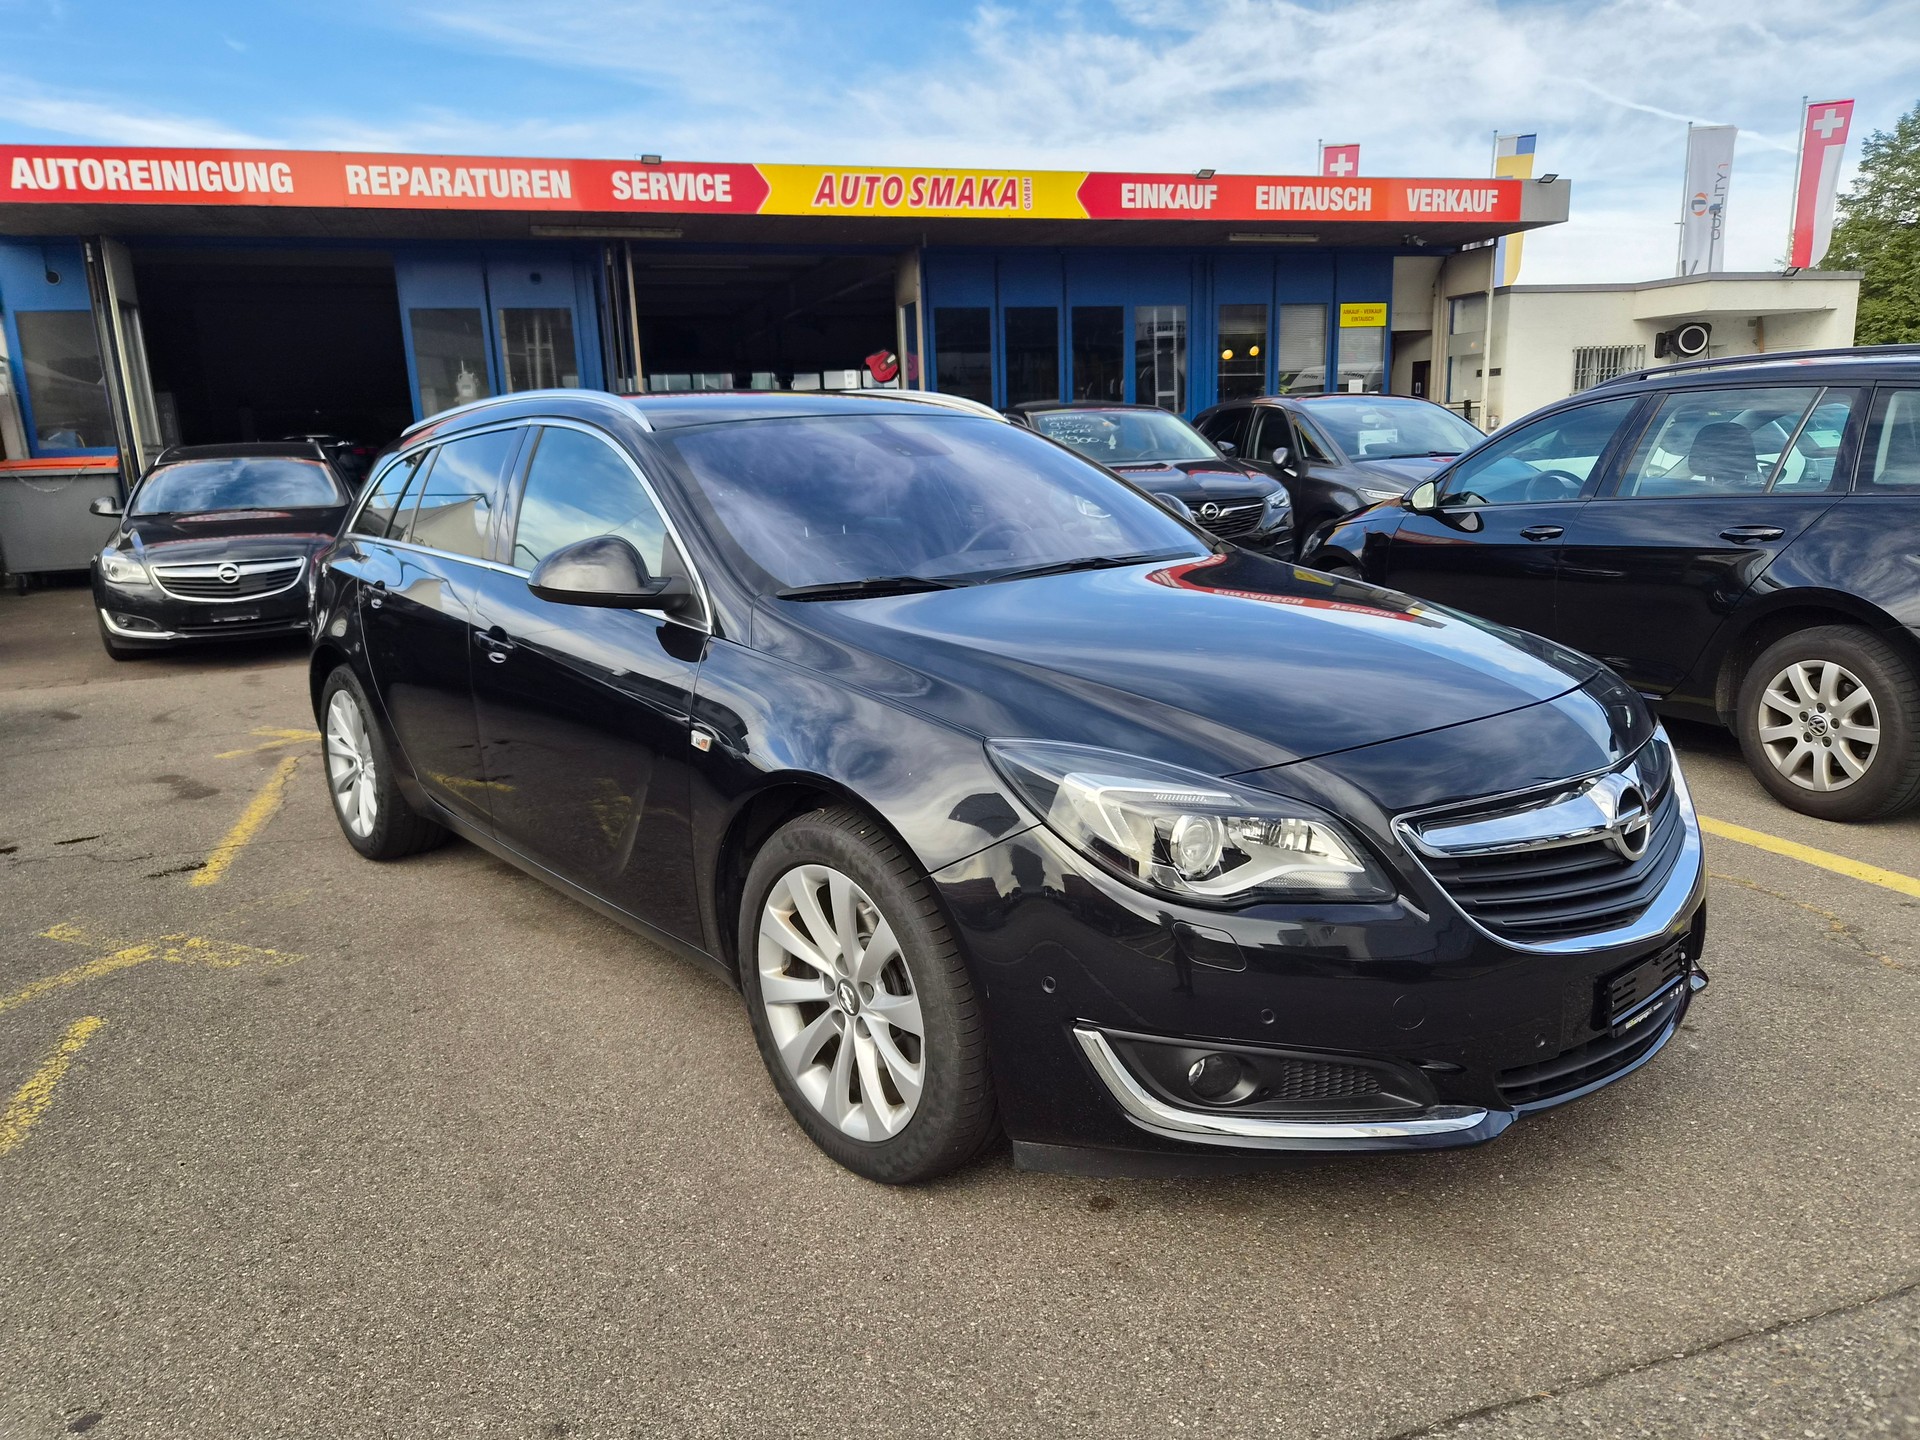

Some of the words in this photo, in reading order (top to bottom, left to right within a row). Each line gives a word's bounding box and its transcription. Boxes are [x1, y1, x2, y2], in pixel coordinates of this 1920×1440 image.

[11, 157, 294, 194] AUTOREINIGUNG
[345, 165, 572, 199] REPARATUREN
[611, 170, 732, 202] SERVICE
[814, 175, 903, 206] AUTO
[909, 177, 1018, 208] SMAKA
[1023, 178, 1031, 209] GMBH
[1121, 183, 1218, 210] EINKAUF
[1255, 185, 1372, 212] EINTAUSCH
[1406, 188, 1499, 213] VERKAUF
